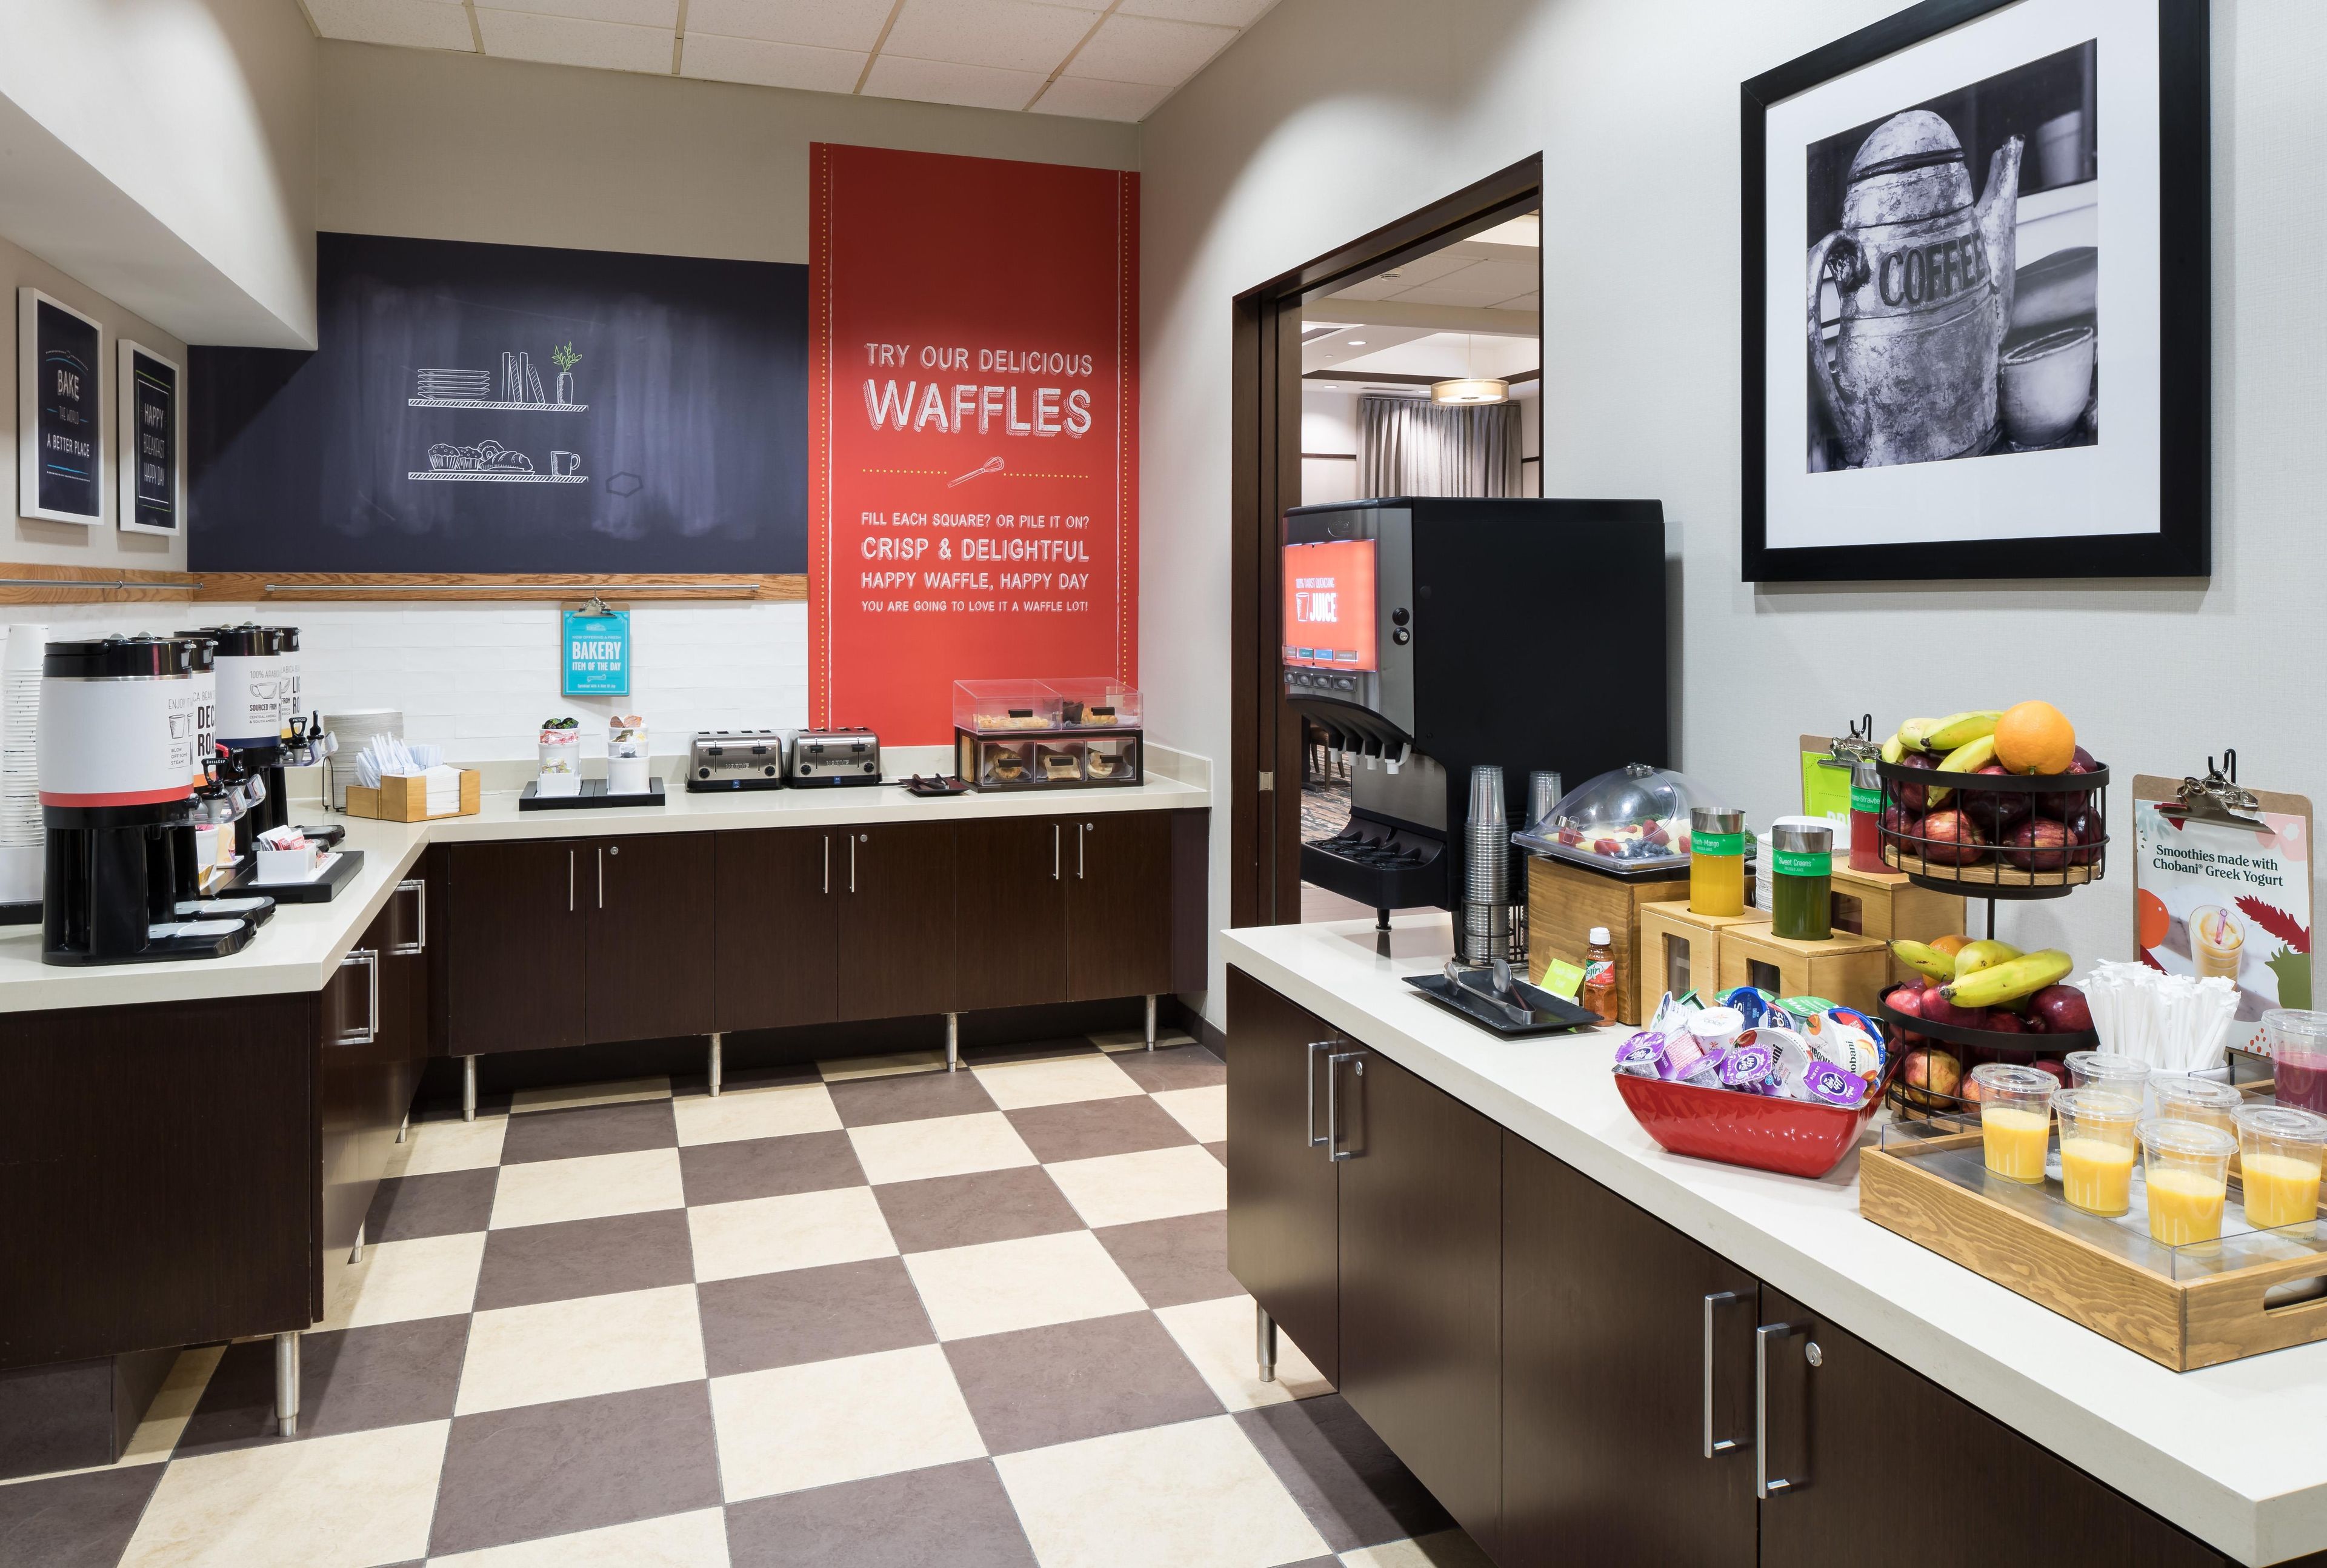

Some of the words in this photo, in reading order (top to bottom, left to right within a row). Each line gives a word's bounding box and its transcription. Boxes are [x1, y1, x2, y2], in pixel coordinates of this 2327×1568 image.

[1879, 229, 1985, 307] COFFEE
[865, 343, 910, 367] TRY
[920, 345, 968, 370] OUR
[978, 348, 1092, 376] DELICIOUS
[58, 370, 79, 402] BAKE
[144, 403, 164, 430] HAPPY
[863, 379, 1092, 439] WAFFLES
[47, 433, 51, 448] A
[53, 434, 73, 454] BETTER
[75, 440, 90, 458] PLACE
[143, 433, 165, 459] BREAKFAST
[144, 462, 157, 485] HAPPY
[861, 512, 887, 526] FILL
[893, 513, 927, 526] EACH
[932, 513, 991, 528] SQUARE?
[996, 514, 1014, 528] OR
[1019, 515, 1045, 528] PILE
[1050, 515, 1061, 528] IT
[1065, 516, 1090, 529] ON?
[861, 537, 928, 560] CRISP
[939, 537, 951, 560] &
[961, 537, 1089, 562] DELIGHTFUL
[861, 572, 916, 589] HAPPY
[924, 573, 994, 591] WAFFLE,
[1000, 573, 1052, 590] HAPPY
[1059, 573, 1089, 590] DAY
[862, 600, 883, 612] YOU
[888, 600, 909, 612] ARE
[914, 600, 947, 612] GOING
[951, 600, 965, 612] TO
[969, 600, 994, 612] LOVE
[998, 600, 1008, 612] IT
[1012, 600, 1019, 612] A
[1023, 600, 1062, 612] WAFFLE
[1067, 600, 1088, 612] LOT!
[1310, 592, 1337, 622] JUICE
[572, 642, 621, 660] BAKERY
[572, 662, 585, 671] ITEM
[588, 662, 595, 671] OF
[597, 662, 608, 671] THE
[610, 662, 621, 671] DAY
[168, 698, 185, 709] ENJOY
[1779, 857, 1792, 866] Sweet
[2156, 844, 2215, 862] Smoothies
[2217, 854, 2249, 867] made
[2251, 859, 2279, 871] with
[2205, 865, 2241, 880] Greek
[2243, 870, 2283, 886] Yogurt
